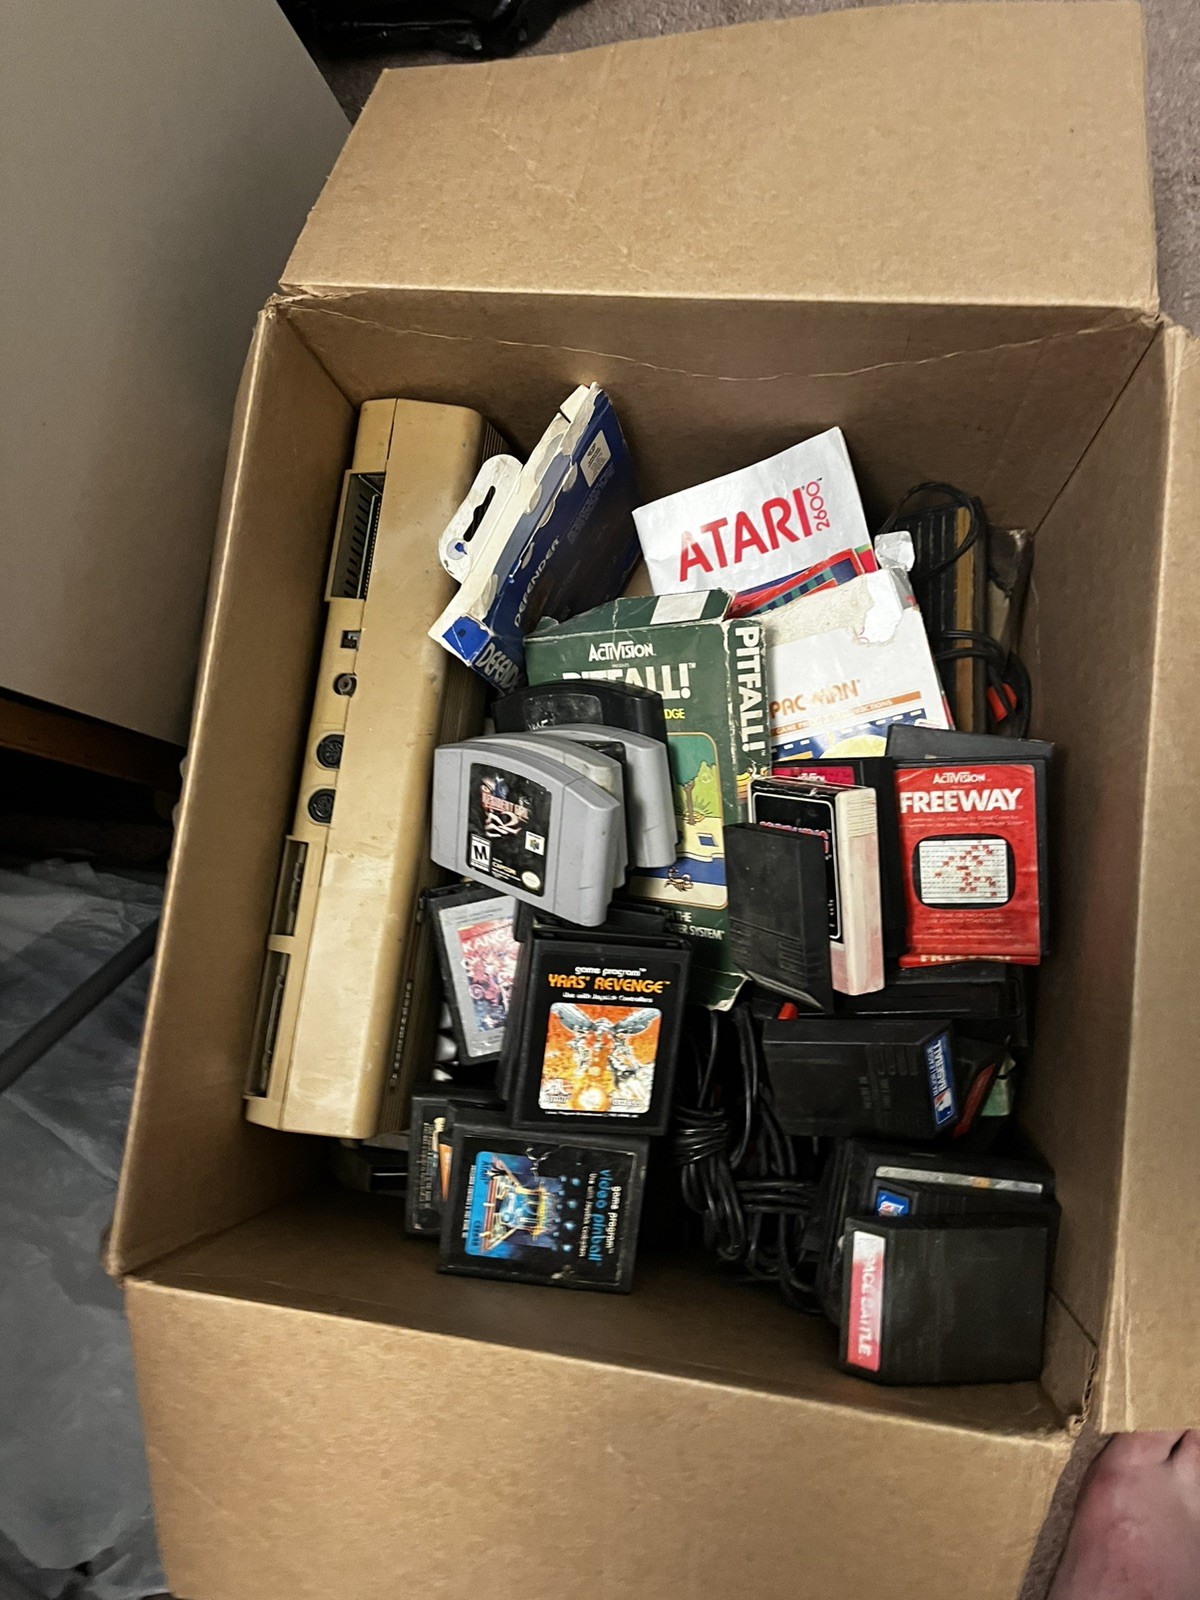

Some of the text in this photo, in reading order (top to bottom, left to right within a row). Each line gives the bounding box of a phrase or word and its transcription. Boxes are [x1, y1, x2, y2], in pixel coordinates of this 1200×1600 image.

[804, 481, 830, 531] 2600
[680, 487, 813, 582] ATARI
[514, 538, 559, 628] DEFENDER
[588, 641, 654, 662] ACTIVISION
[735, 626, 766, 752] PITFALL!
[900, 788, 1023, 814] FREEWAY
[932, 771, 986, 784] ACTIVISION
[473, 845, 488, 861] M
[575, 966, 641, 977] game program
[594, 977, 664, 993] REVENGE
[933, 1039, 948, 1093] BASEBALL
[588, 1170, 613, 1261] video pinball
[605, 1186, 622, 1248] game program
